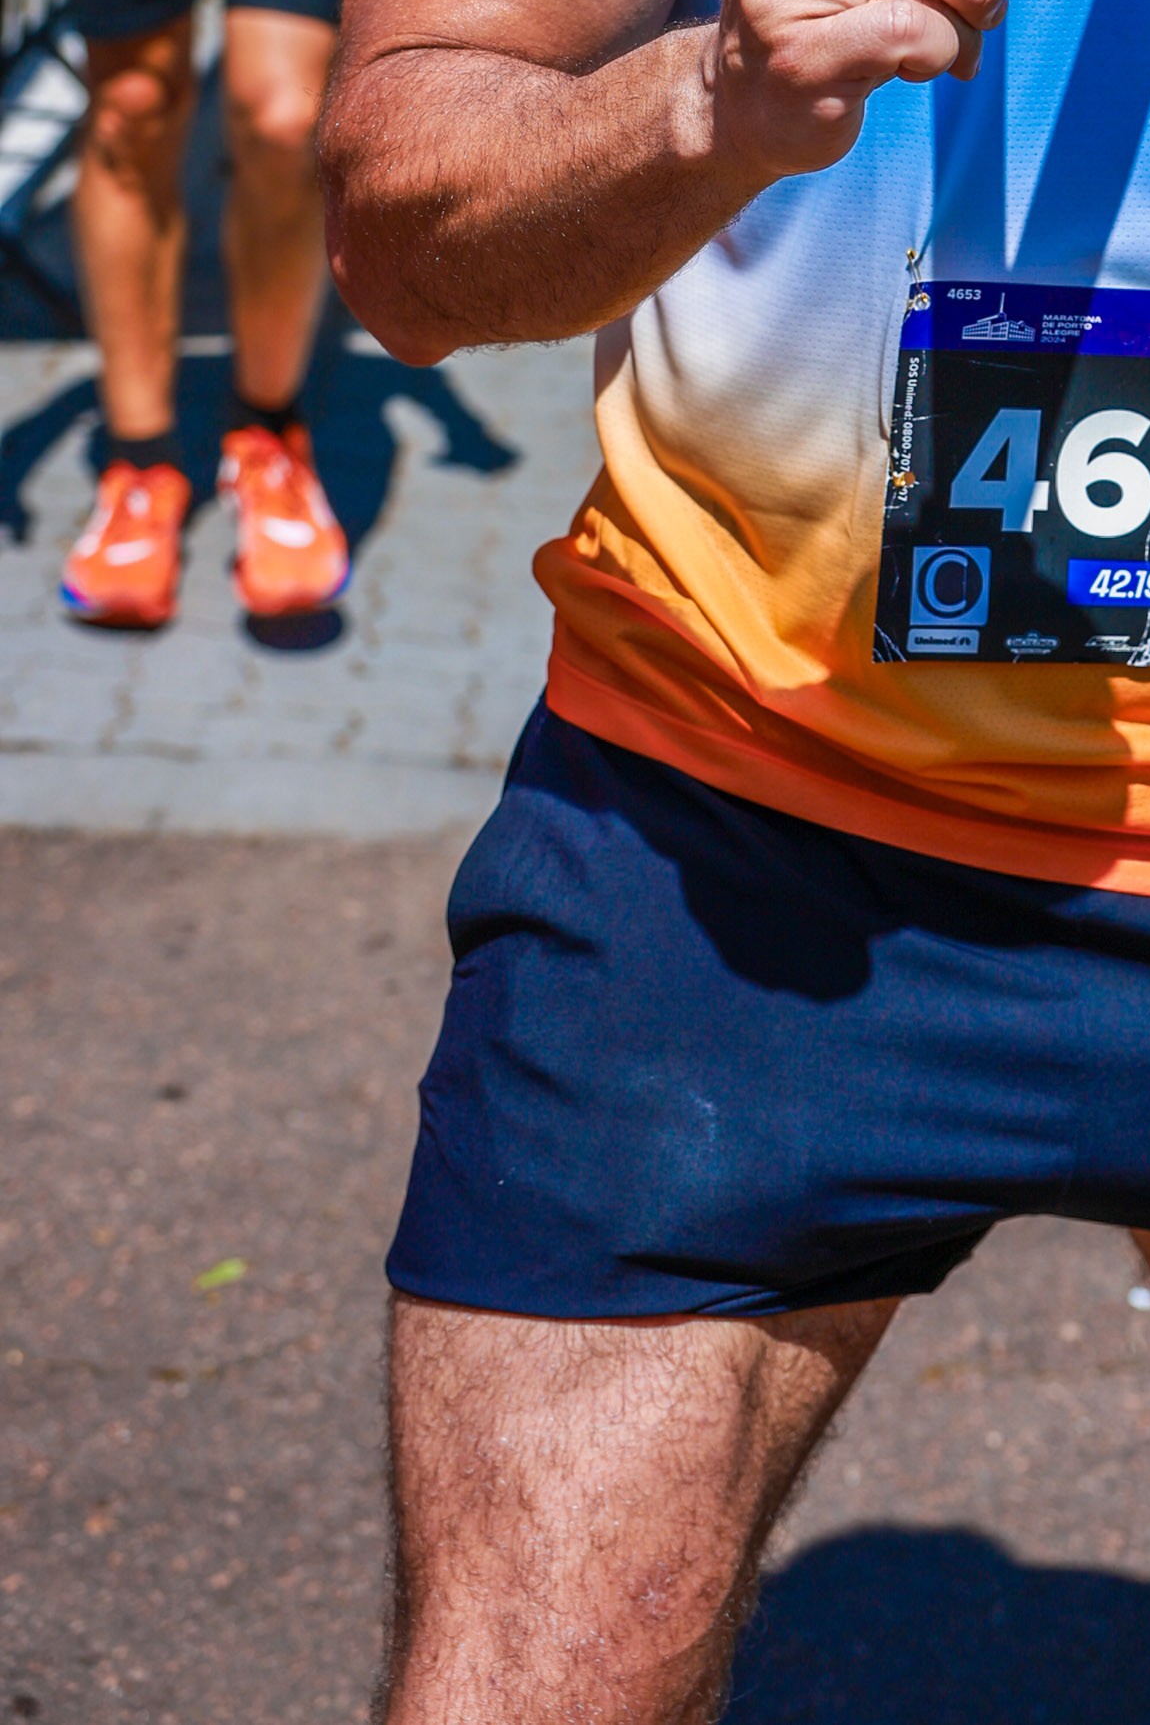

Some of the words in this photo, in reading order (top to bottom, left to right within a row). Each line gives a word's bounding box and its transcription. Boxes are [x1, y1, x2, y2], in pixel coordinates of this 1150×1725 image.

[946, 288, 982, 301] 4653
[1043, 314, 1103, 324] MARATONA
[1042, 321, 1055, 329] DE
[1057, 322, 1092, 331] PORTO
[1041, 329, 1080, 337] ALEGRE
[1040, 335, 1066, 343] 2024
[909, 356, 920, 378] SOS
[903, 379, 917, 421] Unimed:
[914, 635, 956, 647] Unimed
